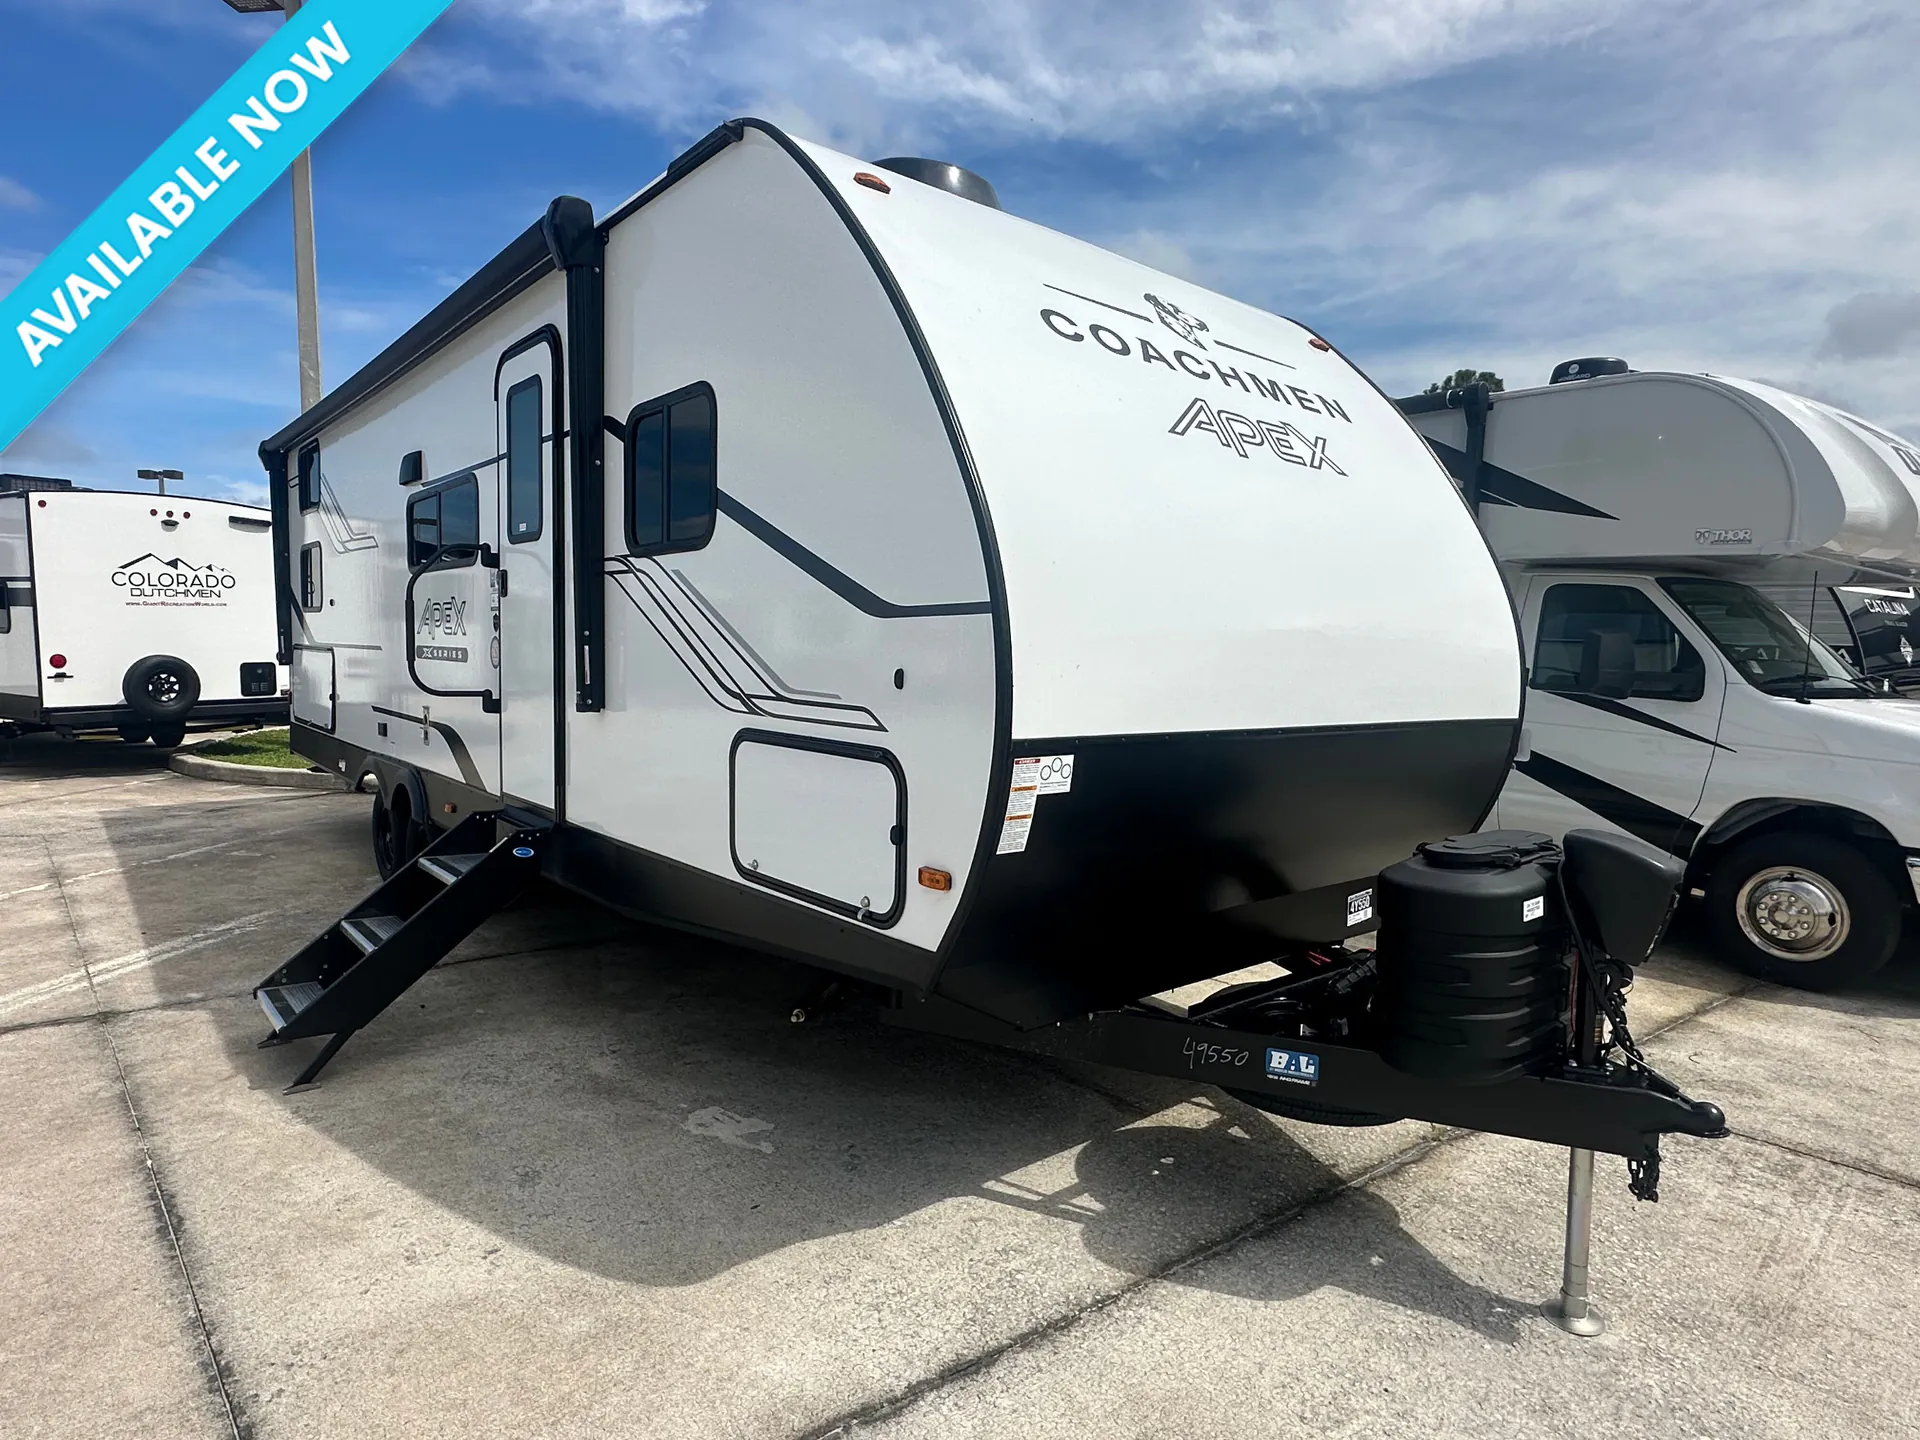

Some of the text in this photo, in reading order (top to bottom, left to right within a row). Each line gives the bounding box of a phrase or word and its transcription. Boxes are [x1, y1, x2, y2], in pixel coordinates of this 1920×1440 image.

[1040, 308, 1352, 424] COACHMEN
[1168, 397, 1349, 477] APEX
[1711, 529, 1752, 541] THOR
[111, 571, 236, 589] COLORADO
[130, 588, 221, 598] DUTCHMEN
[1863, 598, 1911, 616] CATALINA
[416, 596, 467, 640] APEX
[433, 649, 462, 659] SERIES
[1270, 1050, 1315, 1074] BAL
